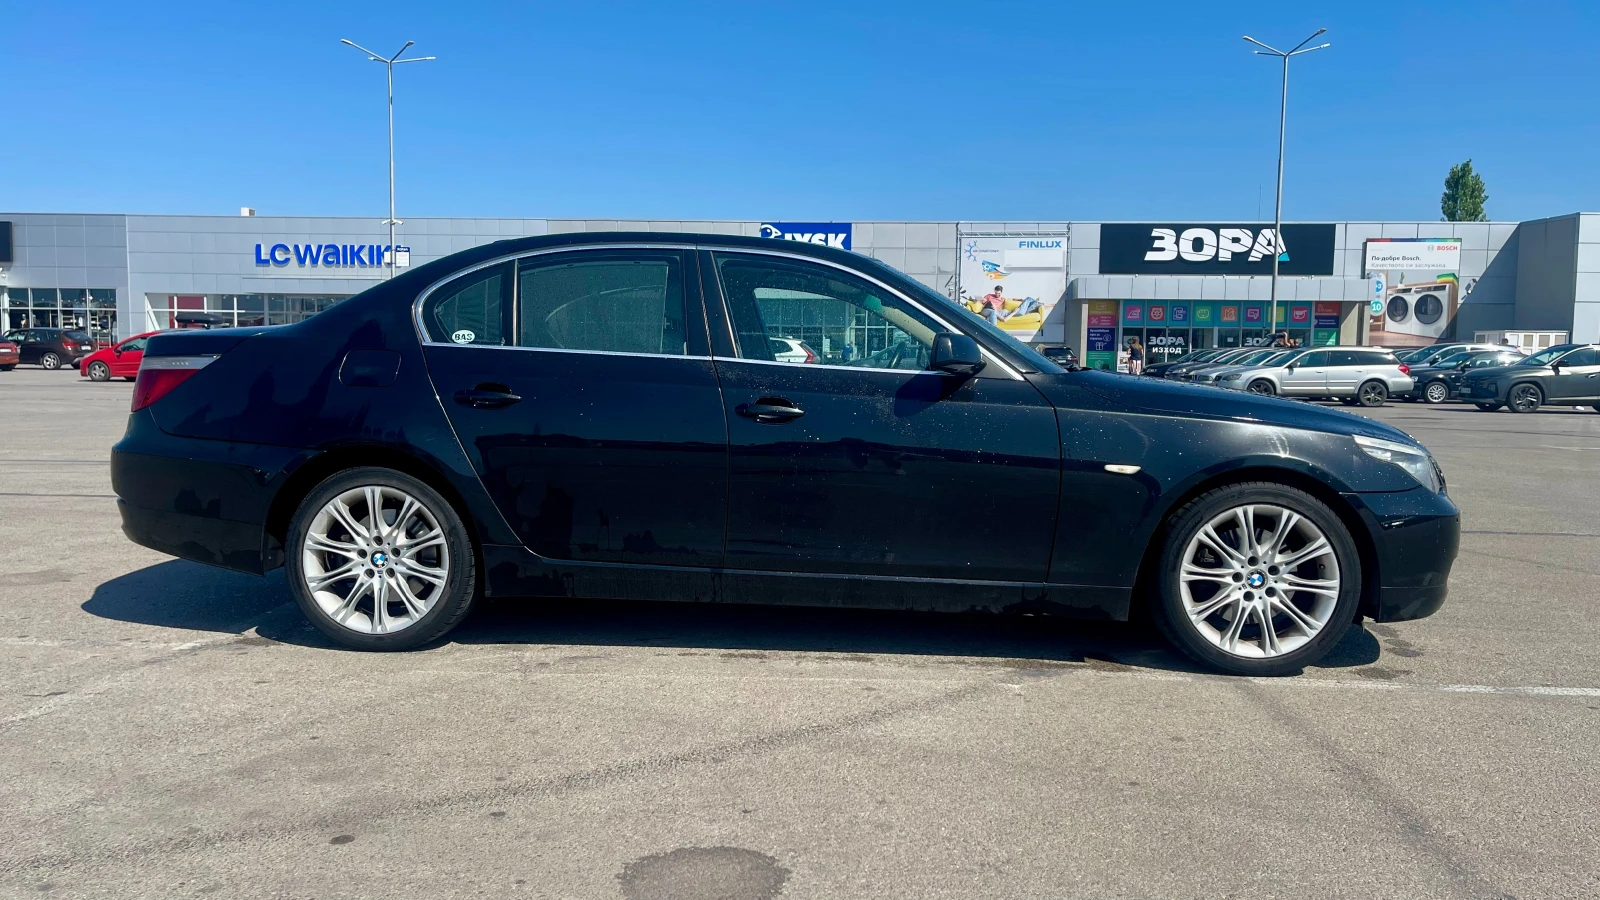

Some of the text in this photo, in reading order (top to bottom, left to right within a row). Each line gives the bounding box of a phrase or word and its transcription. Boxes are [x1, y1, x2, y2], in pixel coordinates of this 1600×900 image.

[1018, 240, 1062, 248] FINLUX
[1144, 228, 1290, 261] ЗОРА
[255, 243, 291, 265] LC
[454, 333, 473, 341] BAS
[1148, 336, 1185, 346] ЗОРА
[1152, 347, 1182, 355] ИЗХОД
